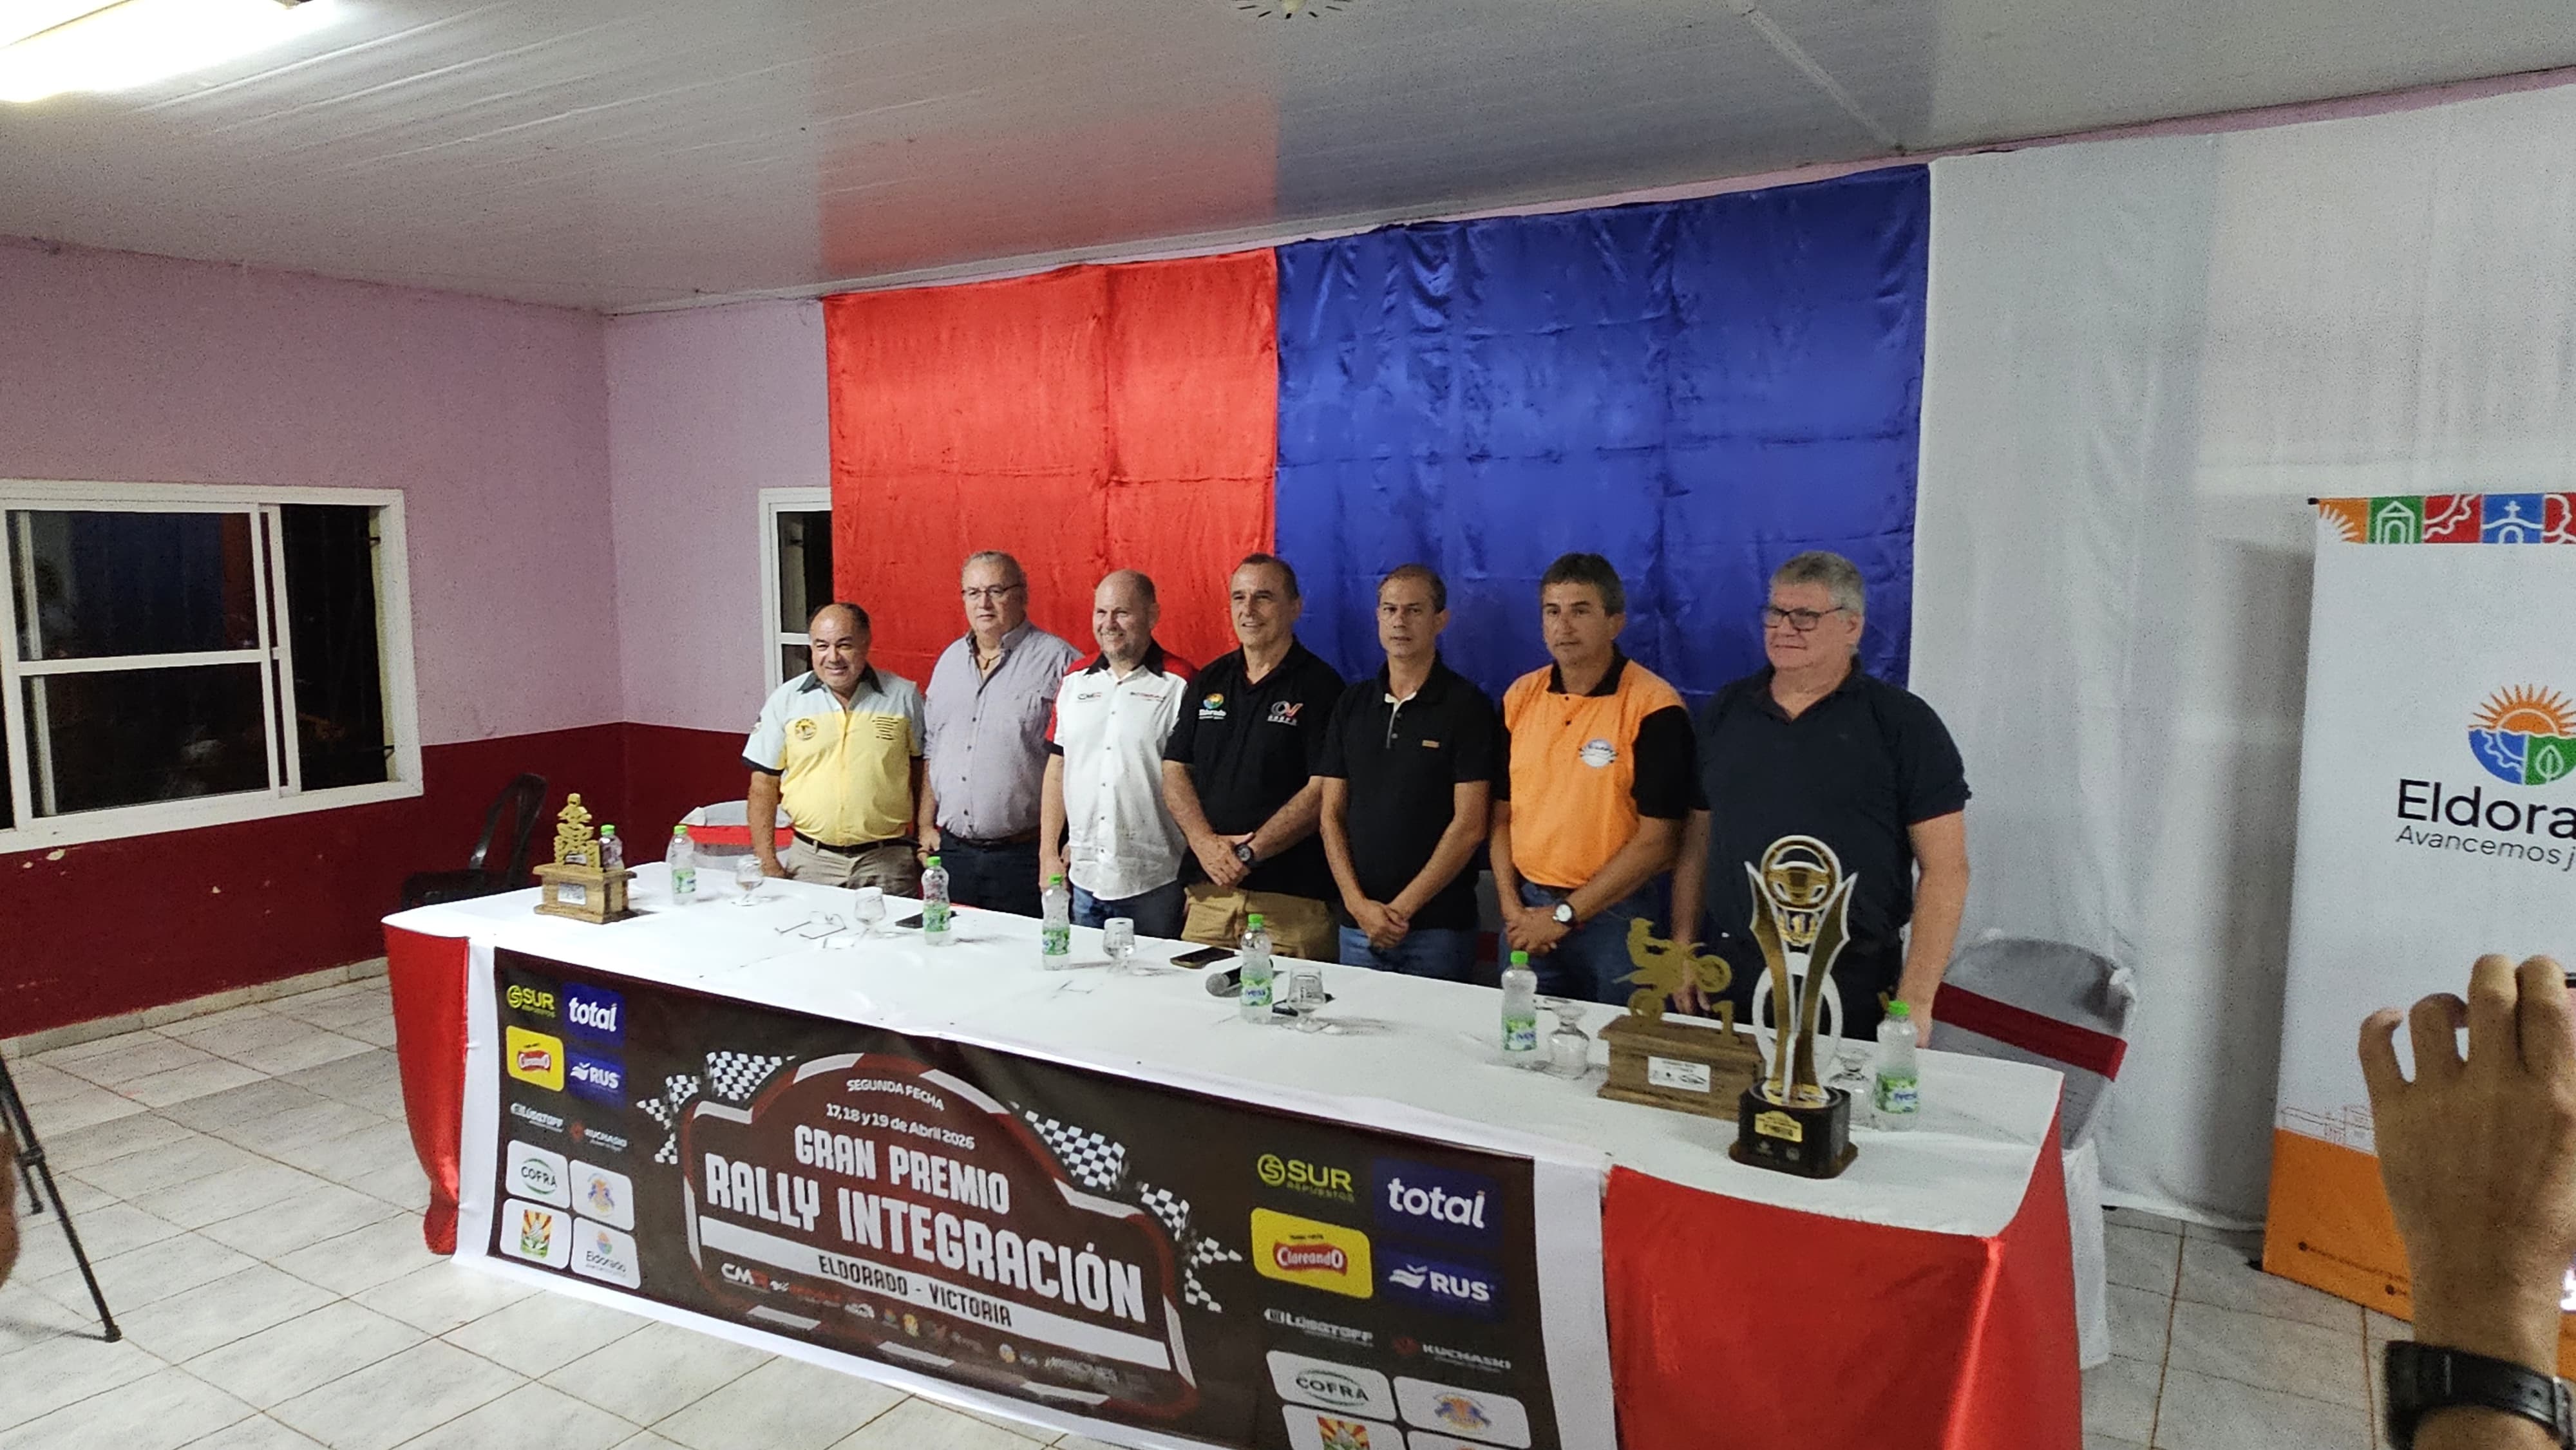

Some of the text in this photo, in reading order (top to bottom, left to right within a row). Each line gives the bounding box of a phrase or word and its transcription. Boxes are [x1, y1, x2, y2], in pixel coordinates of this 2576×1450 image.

[2396, 825, 2562, 864] Avancemos
[522, 988, 555, 1010] SUR
[569, 997, 617, 1032] total
[590, 1068, 620, 1089] RUS
[846, 1079, 945, 1111] SEGUNDA FECHA
[861, 1113, 871, 1125] y
[872, 1113, 889, 1127] 19
[890, 1118, 907, 1133] de
[908, 1122, 942, 1141] Abril
[942, 1129, 976, 1150] 2026
[521, 1166, 557, 1187] COFRA
[794, 1125, 1010, 1215] GRAN PREMIO
[1288, 1160, 1353, 1193] SUR
[1387, 1177, 1485, 1229] total
[705, 1153, 1146, 1324] RALLY INTEGRACIÓN
[818, 1255, 908, 1297] ELDORADO
[929, 1283, 1012, 1327] VICTORIA
[1430, 1270, 1492, 1301] RUS
[1296, 1376, 1369, 1402] COFRA
